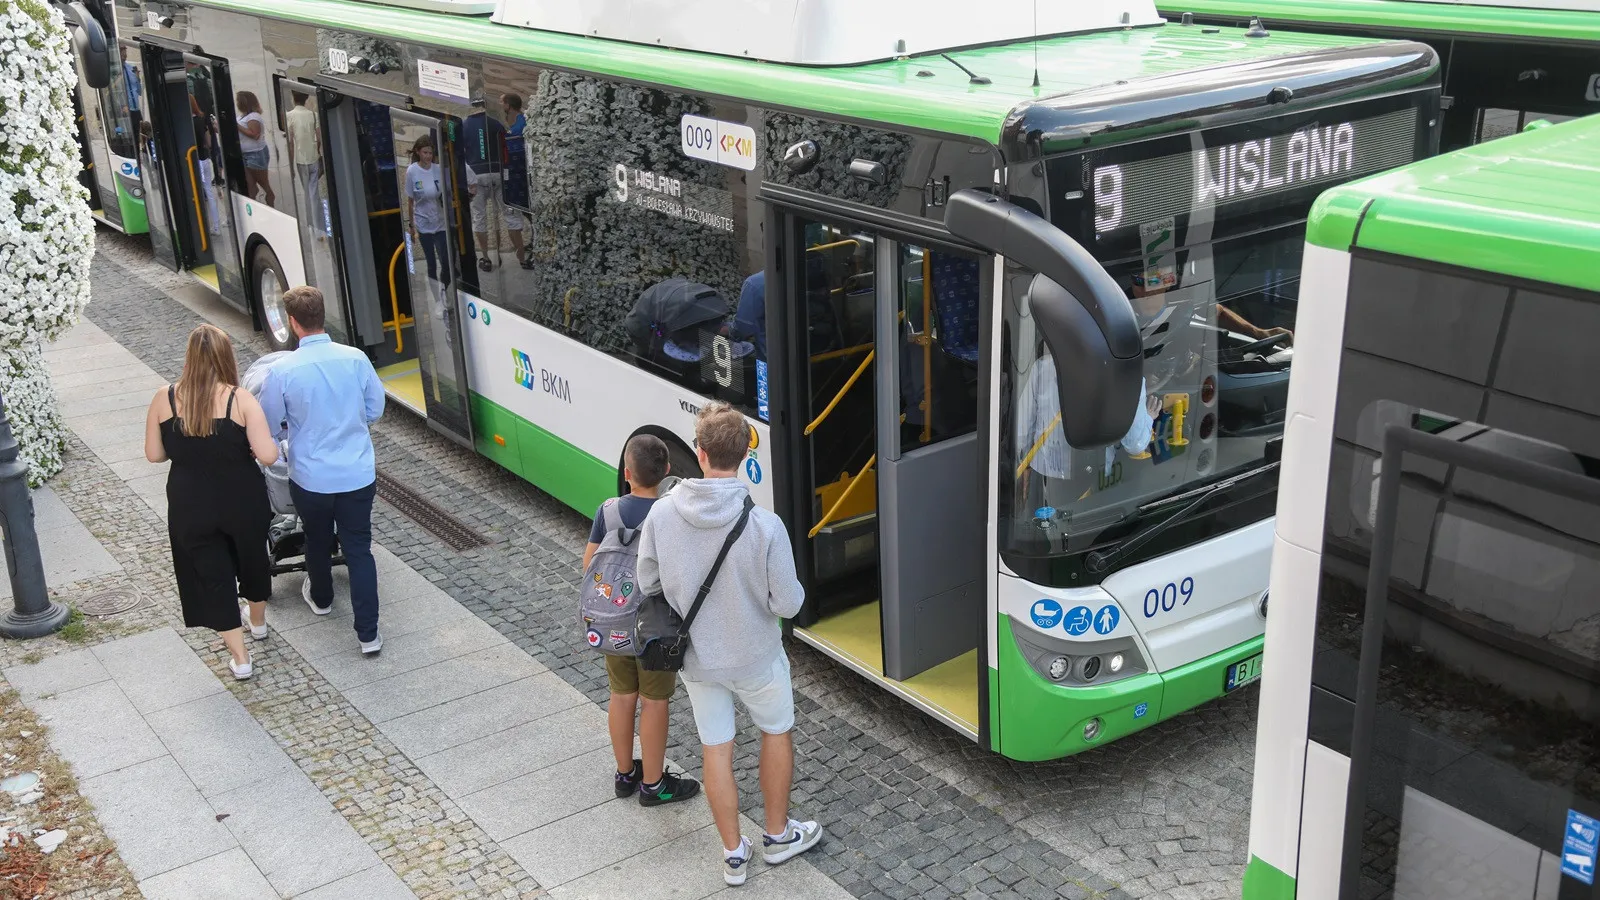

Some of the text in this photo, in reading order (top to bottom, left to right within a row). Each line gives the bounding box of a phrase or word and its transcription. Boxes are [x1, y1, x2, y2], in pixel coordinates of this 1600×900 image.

[330, 50, 347, 71] 009
[686, 124, 713, 151] 009
[615, 163, 629, 202] 9
[1093, 164, 1124, 233] 9
[713, 334, 733, 388] 9
[541, 368, 572, 405] BKM
[1143, 576, 1194, 618] 009
[1237, 659, 1255, 682] BI
